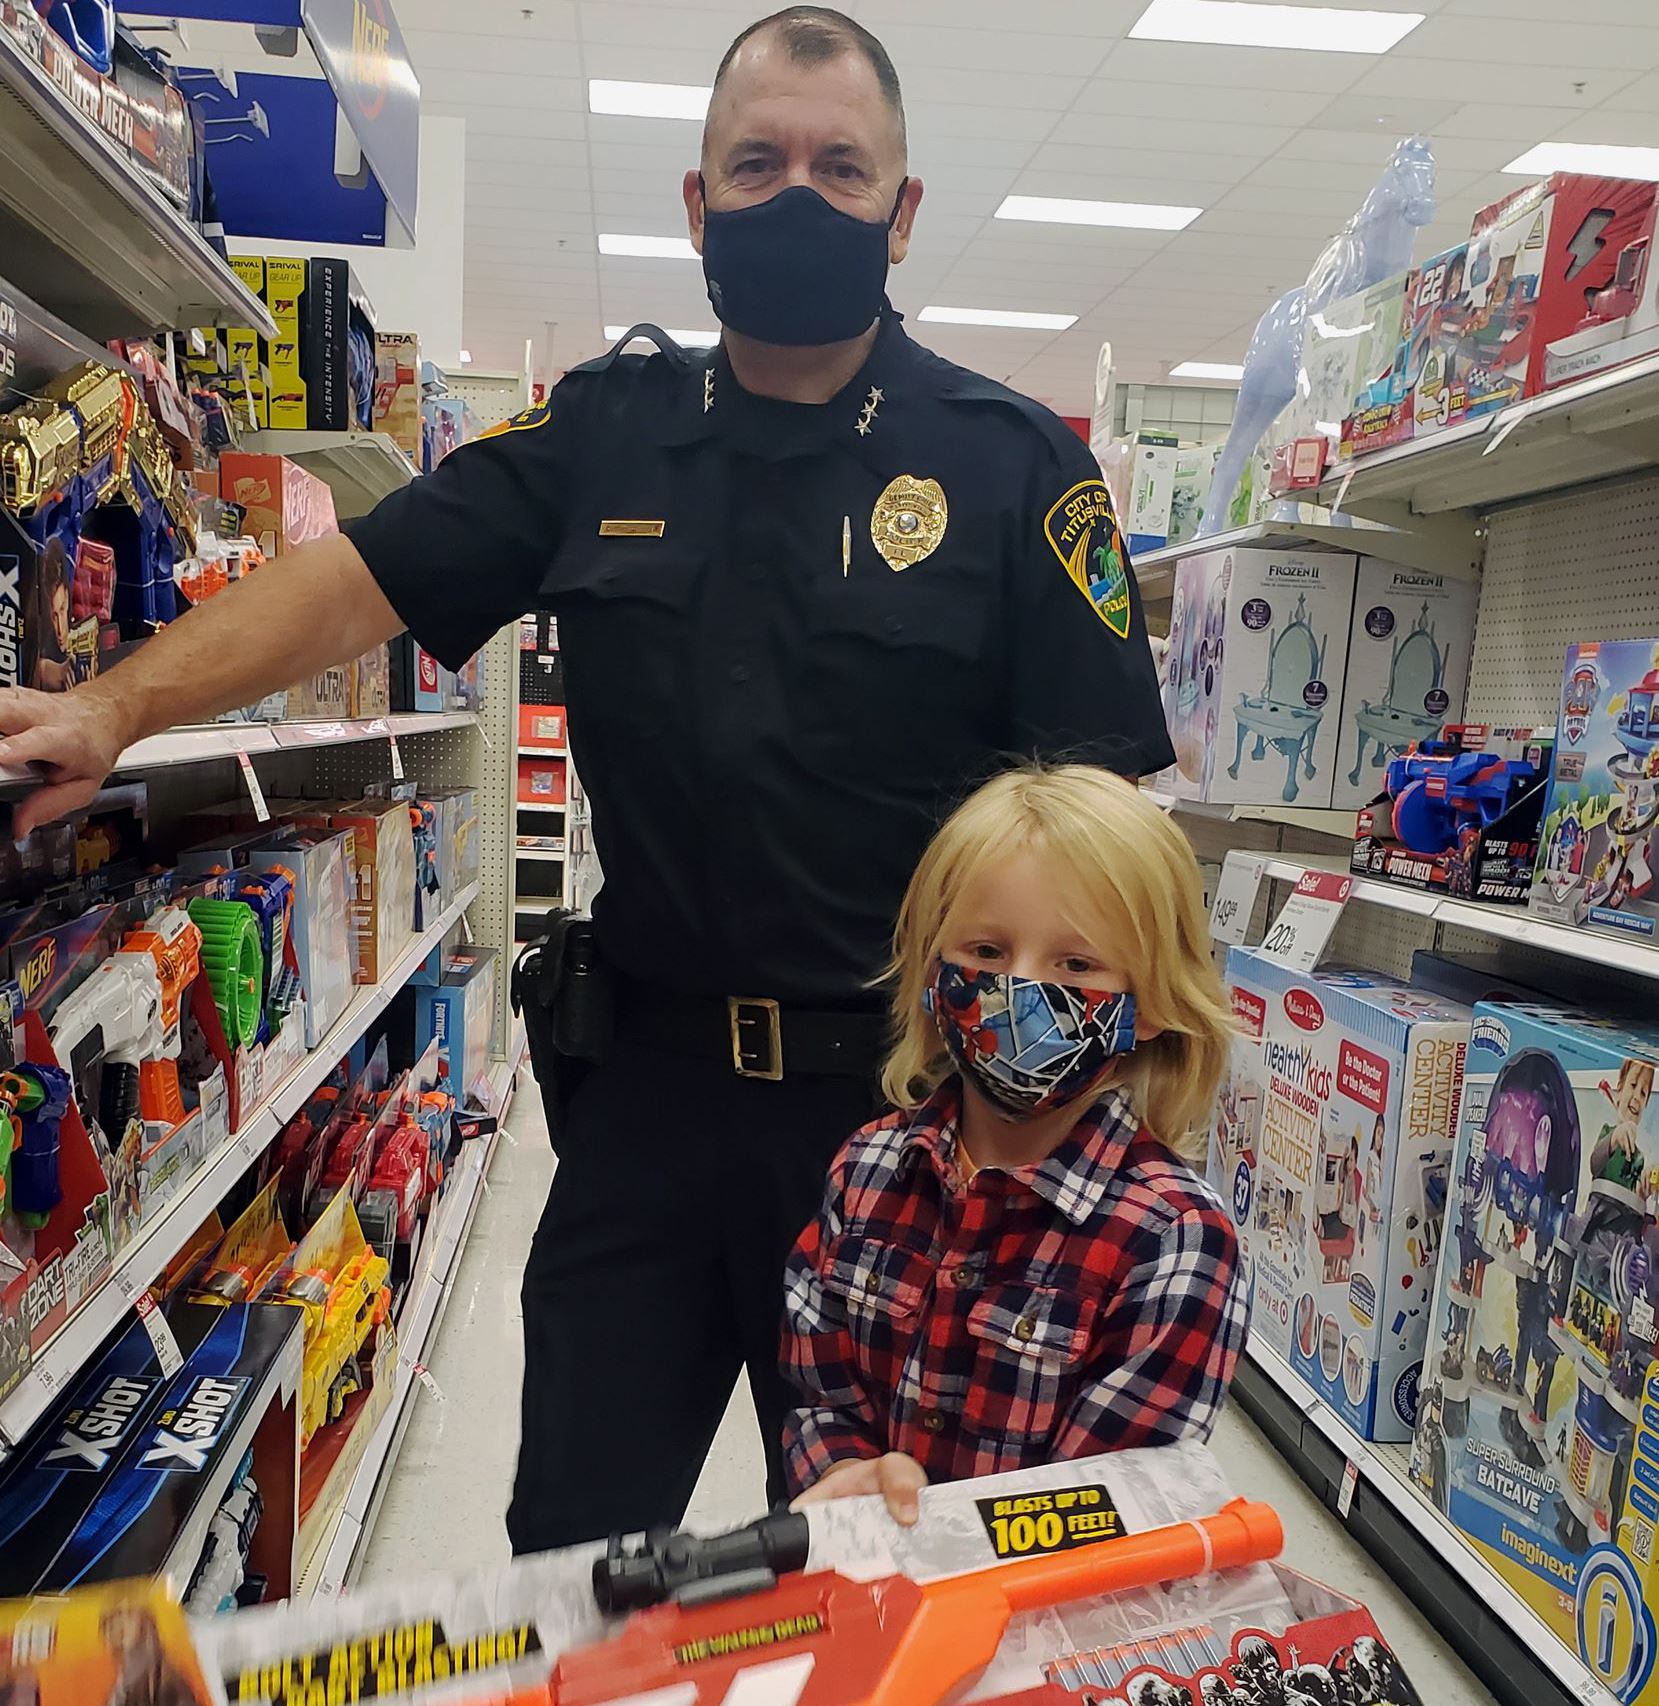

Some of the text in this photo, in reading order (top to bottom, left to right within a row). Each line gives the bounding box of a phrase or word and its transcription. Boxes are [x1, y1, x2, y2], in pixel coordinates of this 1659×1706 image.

[53, 53, 135, 152] POWER MECH
[234, 261, 260, 269] RIVAL
[269, 272, 302, 282] GEAR UP
[275, 262, 302, 270] RIVAL
[324, 266, 333, 340] EXPERIENCE
[1419, 264, 1448, 307] 22
[324, 361, 333, 420] INTENSITY
[1064, 490, 1108, 519] CITY OF
[1268, 565, 1320, 579] FROZEN II
[1392, 573, 1444, 587] FROZEN II
[315, 670, 344, 703] ULTRA
[1312, 683, 1319, 692] 7
[1434, 692, 1440, 700] 7
[1484, 839, 1508, 849] BLASTS
[1487, 847, 1506, 856] UP TO
[1299, 874, 1322, 893] Sale!
[1387, 857, 1414, 879] POWER
[1413, 861, 1433, 883] MECH
[1477, 883, 1520, 899] POWER
[19, 937, 57, 1000] NERF
[1345, 1050, 1383, 1083] Be the Doctor
[1349, 1076, 1358, 1092] the
[1269, 1075, 1291, 1102] DELUXE
[1291, 1087, 1320, 1118] WOODEN
[1408, 1038, 1437, 1141] CENTER
[1429, 1038, 1455, 1138] ACTIVITY
[1447, 1042, 1467, 1139] DELUXE WOODEN
[1264, 1094, 1317, 1149] ACTIVITY
[1262, 1124, 1313, 1187] CENTER
[1235, 1174, 1250, 1210] 37
[27, 1256, 61, 1309] DART
[1258, 1285, 1280, 1314] only at
[29, 1277, 65, 1332] ZONE
[79, 1376, 150, 1437] SHOT
[173, 1377, 239, 1437] SHOT
[1398, 1368, 1418, 1421] ACCESSORIES
[1466, 1437, 1497, 1465] SUPER
[993, 1489, 1101, 1516] BLASTS UP TO
[1477, 1463, 1541, 1514] BATCAVE
[990, 1510, 1117, 1554] 100 FEET!
[1501, 1522, 1579, 1586] imaginext
